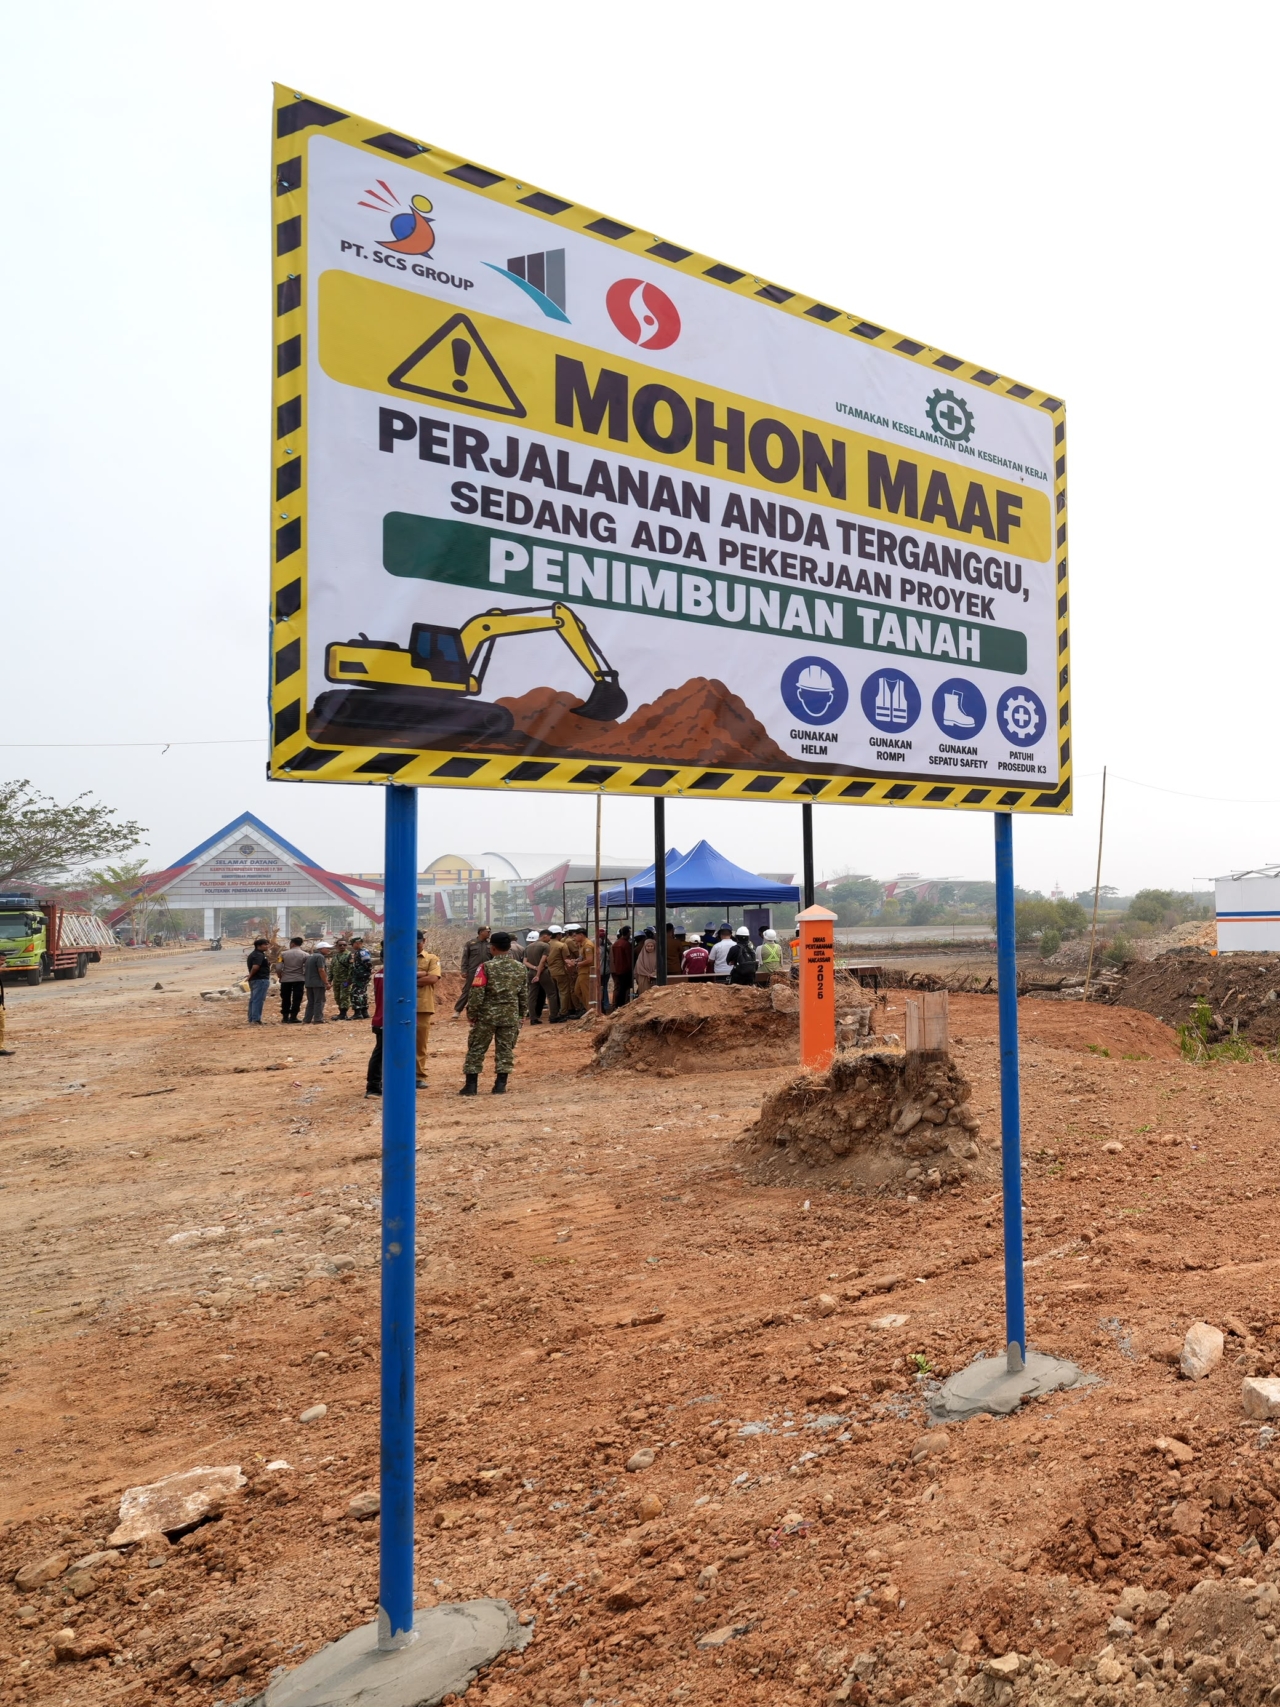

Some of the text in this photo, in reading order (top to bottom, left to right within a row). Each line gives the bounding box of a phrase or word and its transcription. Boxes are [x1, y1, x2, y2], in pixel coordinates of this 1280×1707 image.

[340, 240, 475, 291] PT. SCS GROUP
[555, 353, 1023, 545] MOHON MAAF
[835, 402, 1048, 482] UTAMAKAN KESELAMATAN DAN KESEHATAN KERJA
[379, 406, 1030, 603] PERJALANAN ANDA TERGANGGU,
[450, 481, 996, 621] SEDANG ADA PEKERJAAN PROYEK
[489, 536, 981, 663] PENIMBUNAN TANAH
[789, 729, 838, 743] GUNAKAN
[869, 736, 912, 750] GUNAKAN
[801, 743, 828, 756] HELM
[876, 749, 905, 762] ROMPI
[938, 743, 978, 756] GUNAKAN
[1009, 750, 1034, 762] PATUHI
[928, 755, 988, 769] SEPATU SAFETY
[997, 761, 1047, 774] PROSEDUR K3
